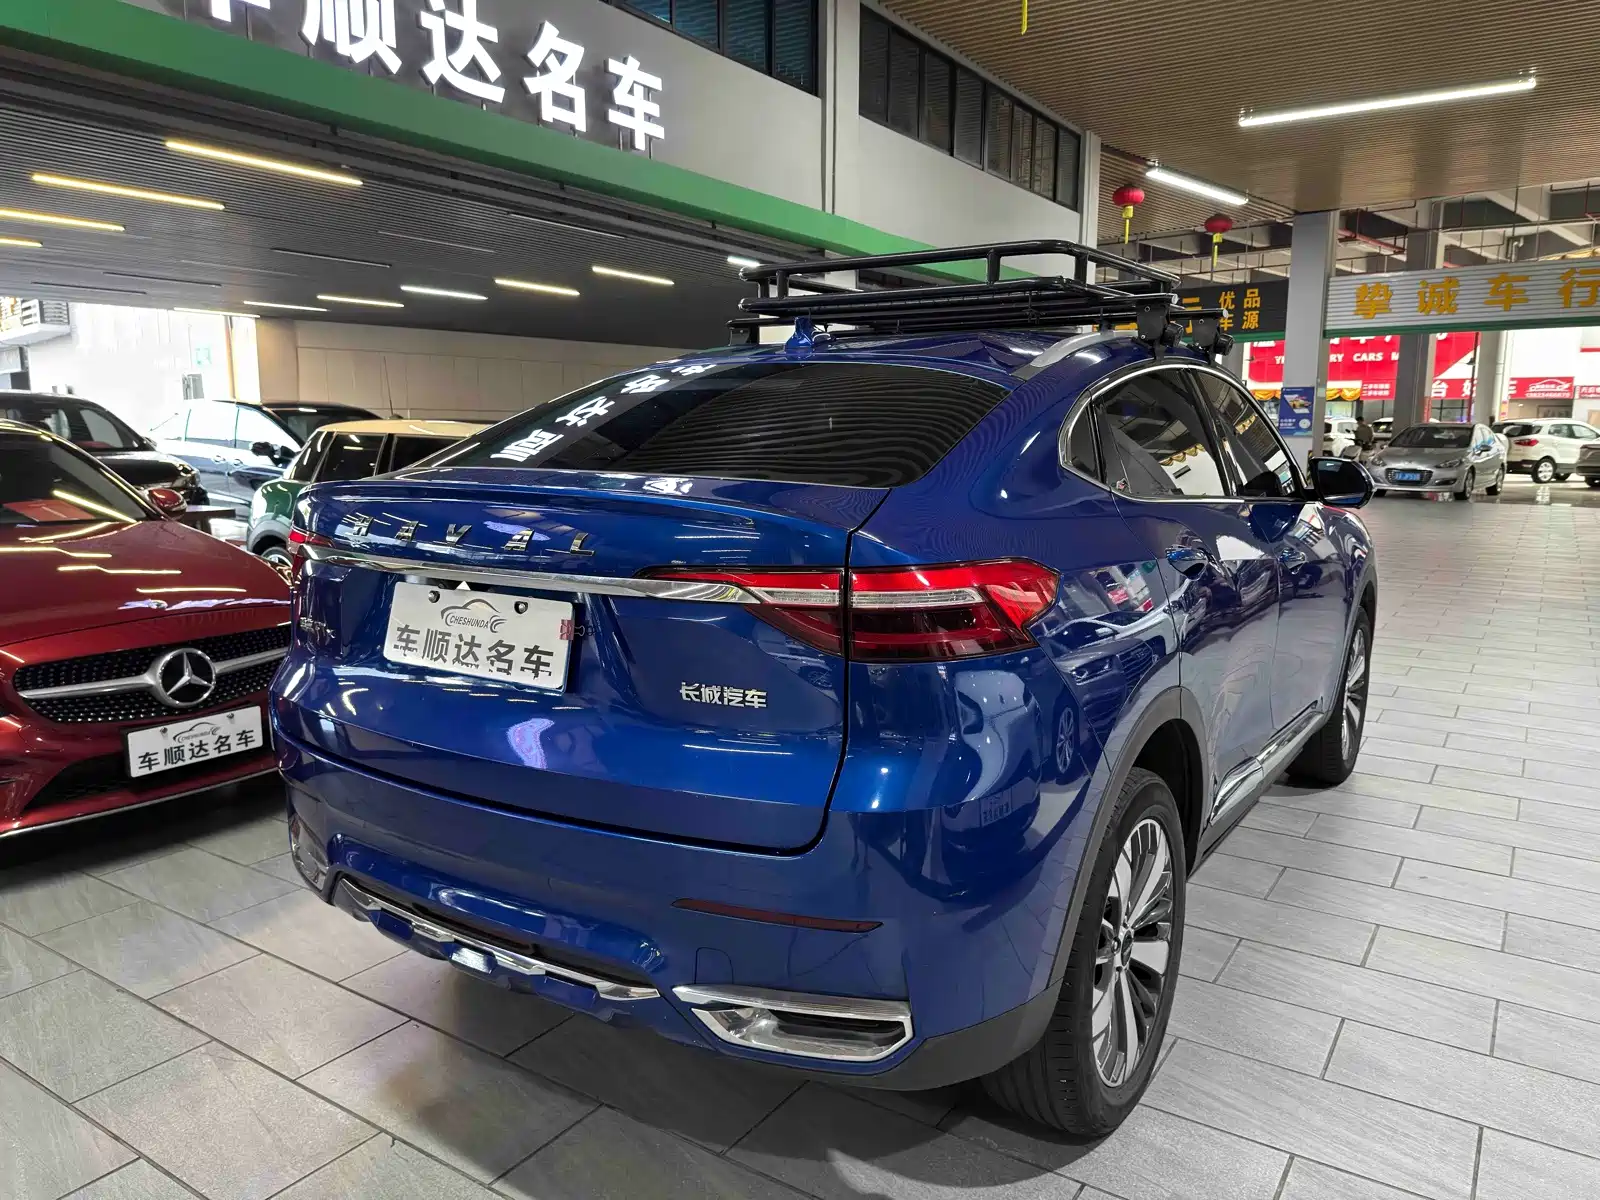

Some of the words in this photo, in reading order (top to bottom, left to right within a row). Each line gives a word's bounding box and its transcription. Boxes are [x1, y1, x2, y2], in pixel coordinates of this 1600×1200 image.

[206, 0, 665, 151] 顺达名车
[1219, 288, 1261, 310] 优品
[1354, 267, 1600, 320] 挚诚车行
[1353, 352, 1384, 362] CARS
[353, 516, 595, 557] HAVAL
[449, 614, 490, 630] CHESHUNDA
[393, 624, 555, 680] 车顺达名车
[680, 681, 768, 709] 长城汽车
[138, 729, 257, 771] 车顺达名车
